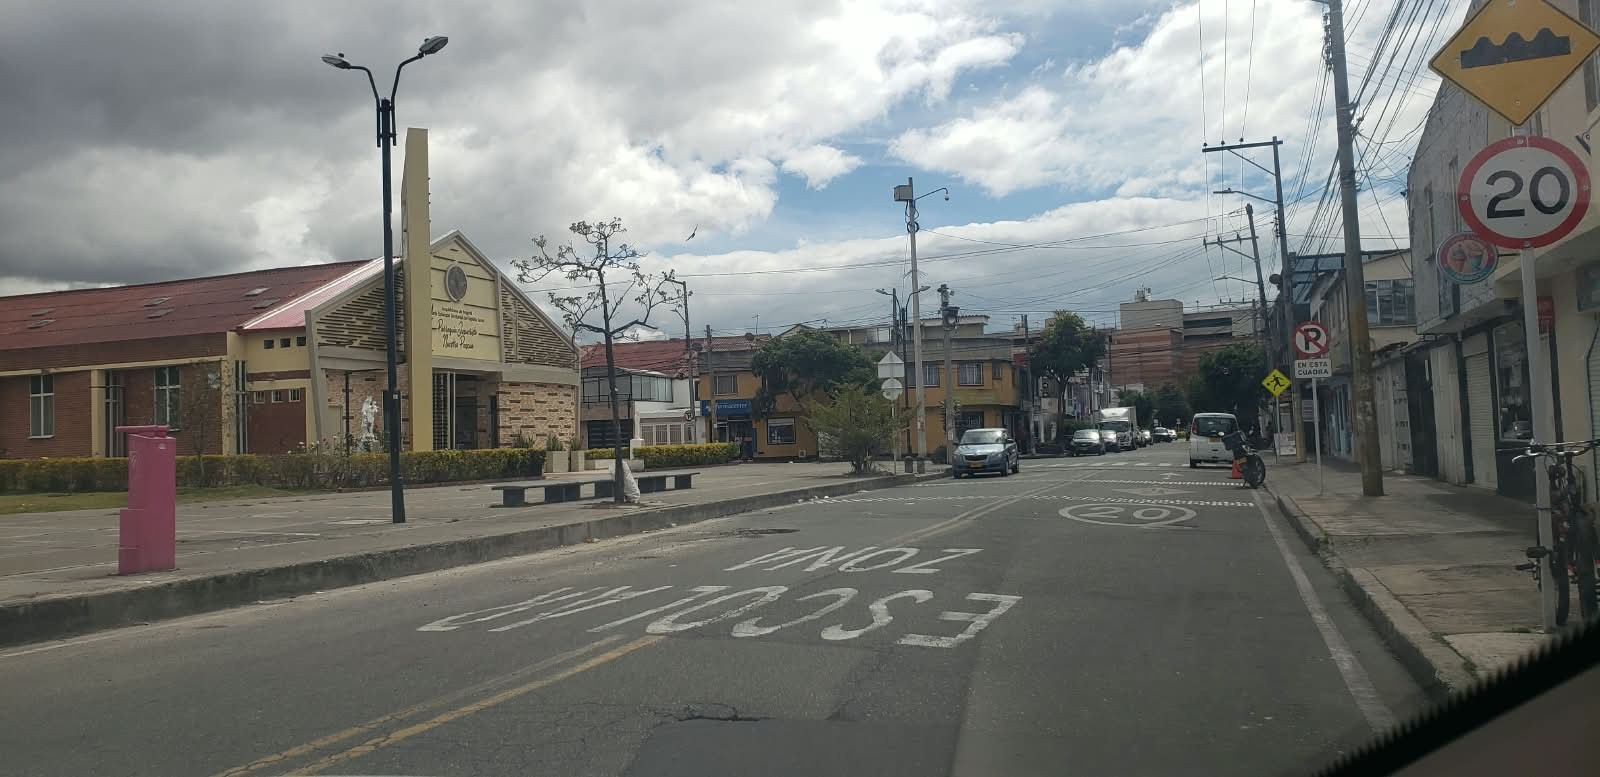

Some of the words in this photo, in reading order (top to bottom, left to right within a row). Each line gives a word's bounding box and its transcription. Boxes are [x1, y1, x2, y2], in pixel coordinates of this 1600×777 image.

[1485, 166, 1570, 219] 20
[1297, 368, 1329, 376] CUADRA
[1077, 505, 1172, 520] 20
[722, 545, 984, 574] ZONA
[416, 585, 1023, 648] ESCOLAR
